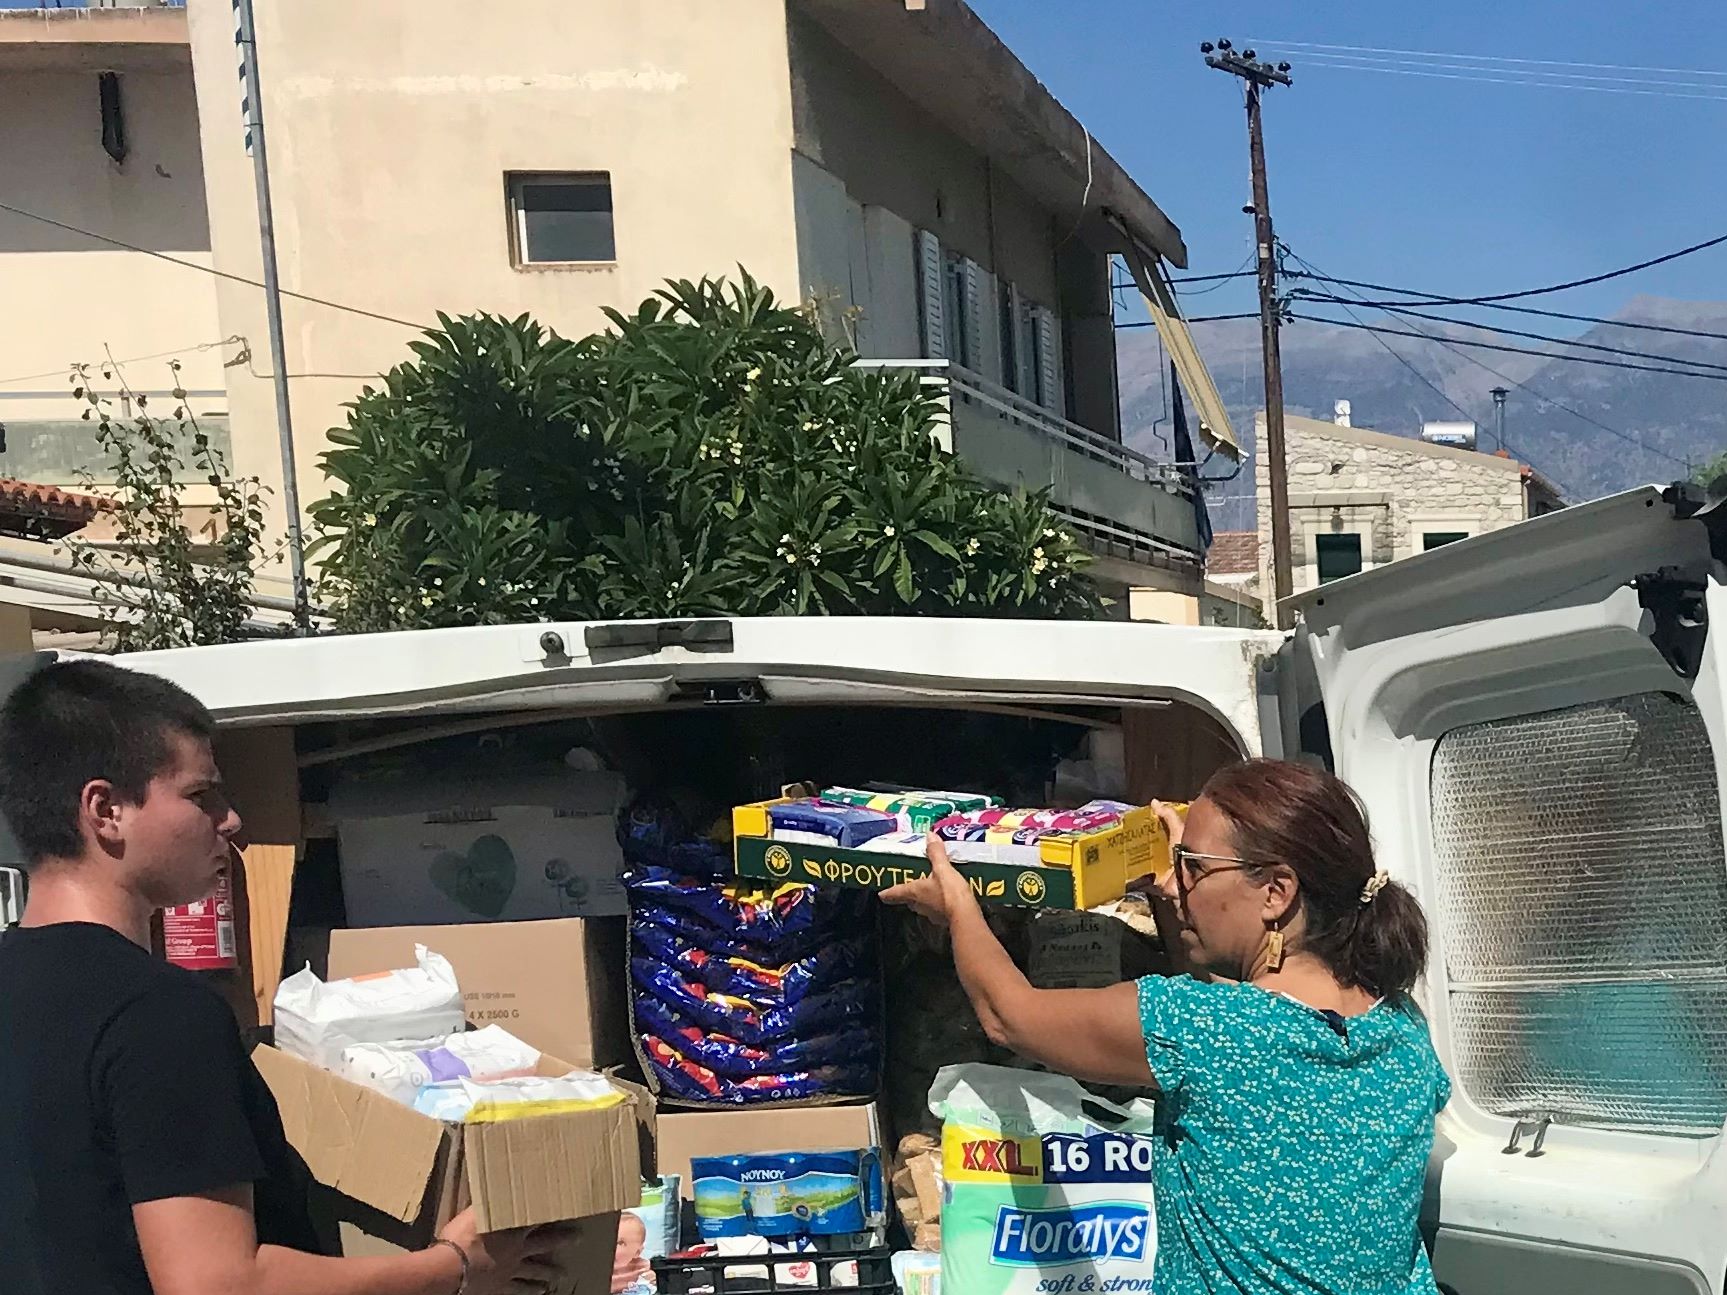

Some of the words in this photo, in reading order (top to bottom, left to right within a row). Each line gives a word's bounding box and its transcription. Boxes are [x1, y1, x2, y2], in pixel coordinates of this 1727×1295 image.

[469, 1011, 475, 1020] 4
[487, 1009, 509, 1020] 2500
[1047, 1140, 1090, 1173] 16
[999, 1212, 1143, 1265] Floralys
[1036, 1273, 1076, 1295] soft
[1077, 1274, 1096, 1293] &
